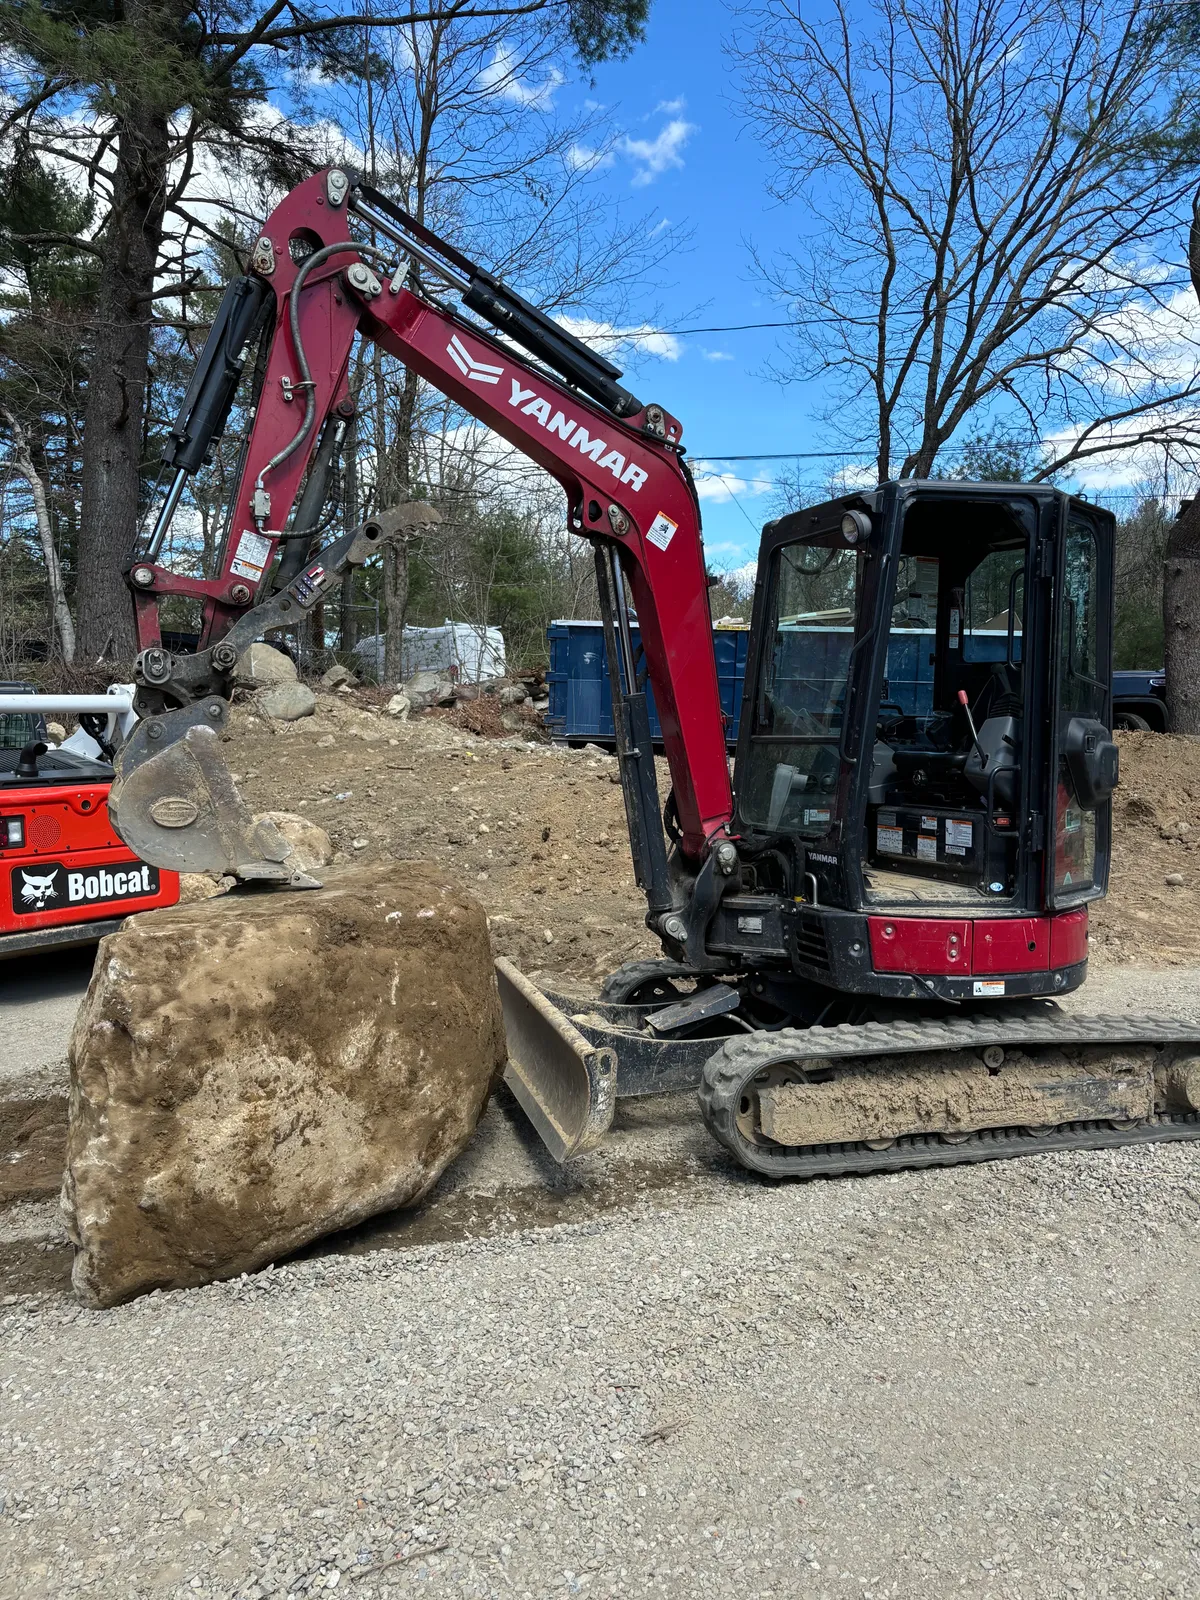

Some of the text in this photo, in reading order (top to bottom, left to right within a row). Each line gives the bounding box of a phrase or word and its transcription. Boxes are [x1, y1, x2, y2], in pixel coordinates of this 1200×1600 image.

[508, 378, 649, 492] YANMAR
[808, 852, 838, 865] YANMAR
[68, 866, 150, 901] Bobcat
